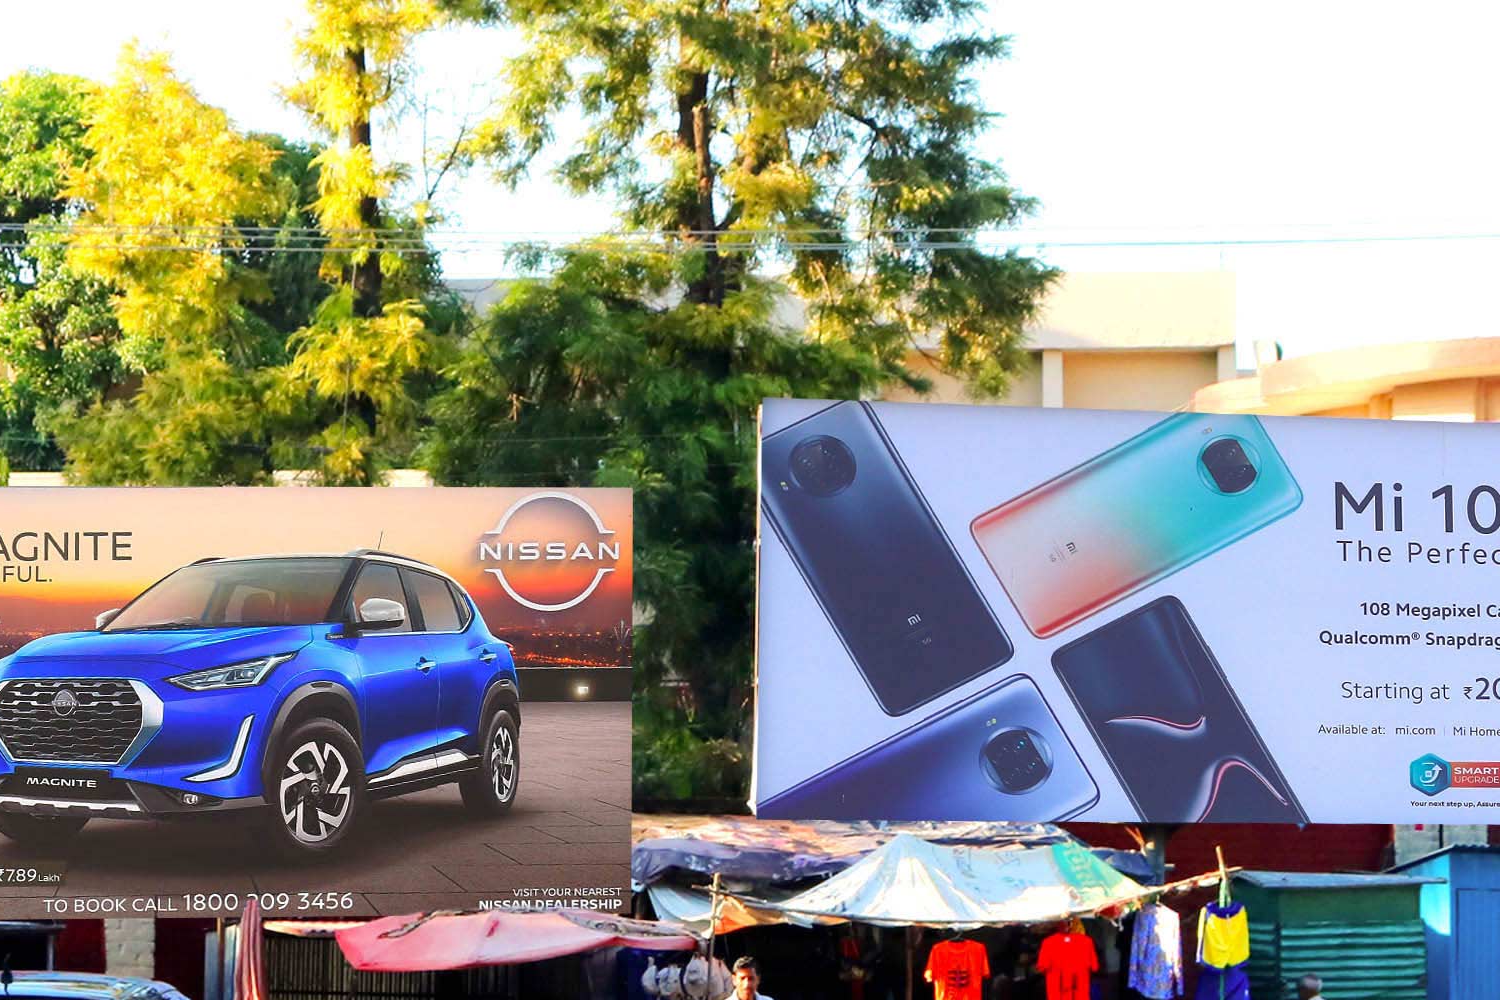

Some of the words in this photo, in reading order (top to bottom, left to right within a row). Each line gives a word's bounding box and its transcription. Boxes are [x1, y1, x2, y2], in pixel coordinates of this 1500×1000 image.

[1334, 481, 1403, 532] Mi
[1432, 484, 1500, 534] 10
[480, 542, 620, 560] NISSAN
[1336, 540, 1392, 562] The
[1360, 603, 1390, 616] 108
[1396, 603, 1481, 620] Megapixel
[1341, 681, 1423, 704] Starting
[1430, 684, 1450, 700] at
[1318, 724, 1368, 735] Available
[1371, 726, 1386, 735] at:
[1395, 725, 1436, 736] mi.com
[1453, 726, 1466, 736] Mi
[1454, 767, 1499, 775] SMART
[26, 777, 97, 788] MAGNITE
[1454, 775, 1499, 784] UPGRADE
[512, 888, 539, 896] VISIT
[541, 888, 571, 896] YOUR
[574, 887, 622, 896] NEAREST
[43, 899, 68, 912] TO
[74, 898, 126, 912] BOOK
[132, 898, 178, 912] CALL
[183, 893, 238, 911] 1800
[297, 892, 353, 909] 3456
[479, 900, 531, 910] NISSAN
[535, 899, 622, 910] DEALERSHIP
